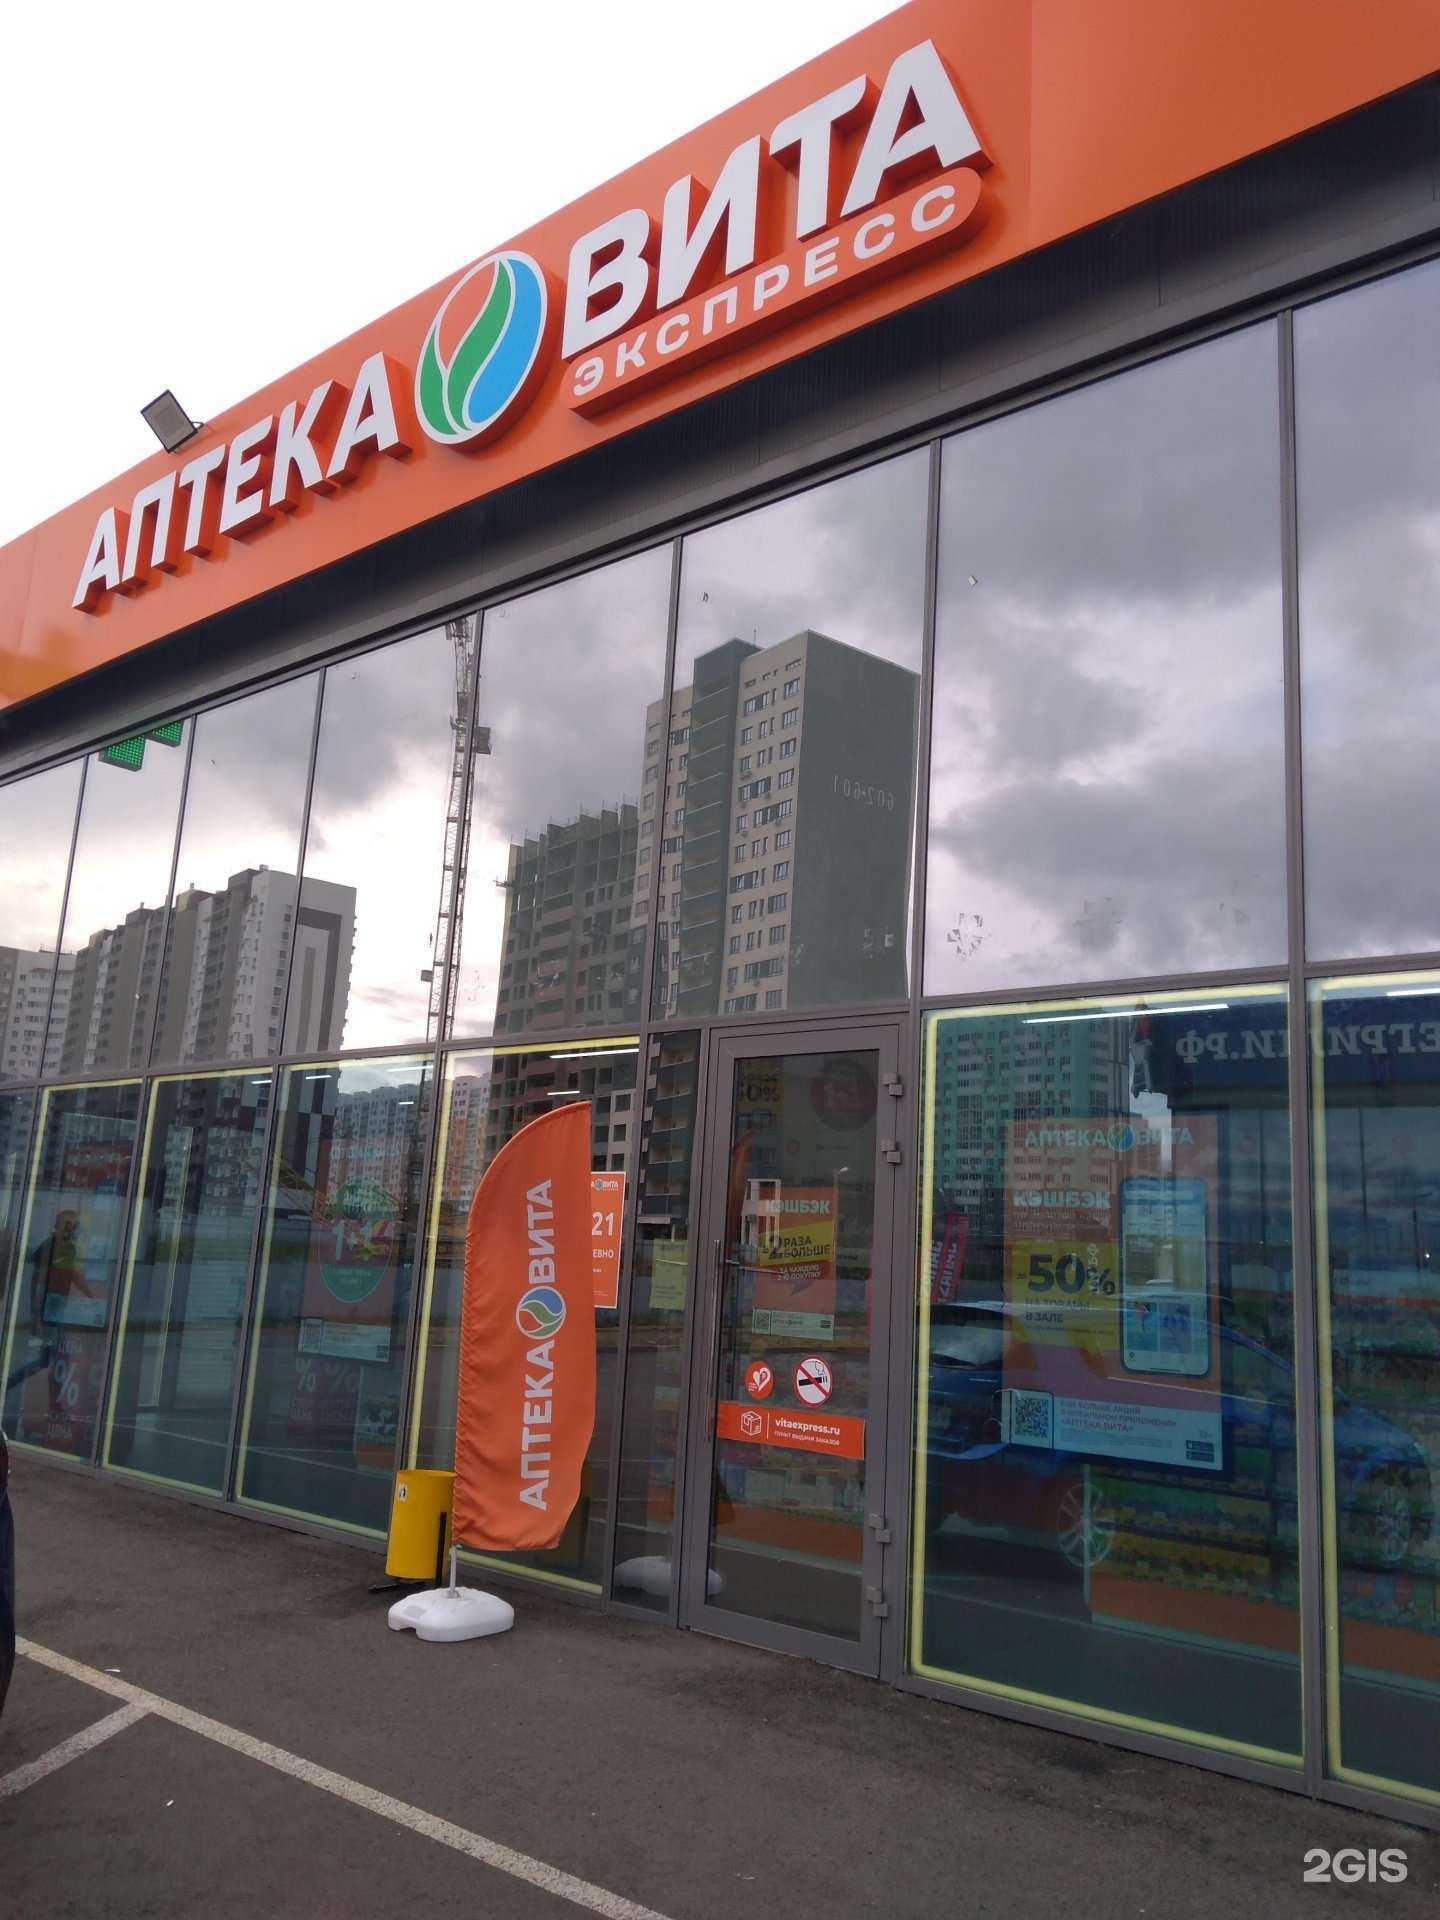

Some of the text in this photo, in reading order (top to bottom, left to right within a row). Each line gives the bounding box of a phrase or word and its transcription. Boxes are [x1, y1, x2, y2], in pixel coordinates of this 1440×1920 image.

[573, 185, 956, 396] ЭКСПРЕСС
[72, 39, 983, 609] АПТЕКА ВИТА
[1025, 1127, 1107, 1148] АПТЕКА
[765, 1200, 831, 1215] КЭШБЭК
[784, 1235, 812, 1248] РАЗА
[784, 1244, 831, 1258] БОЛЬШЕ
[1035, 1312, 1063, 1323] ЗАЛЕ
[520, 1180, 556, 1511] АПТЕКА ВИТА
[775, 1417, 840, 1436] vitaexpress.ru
